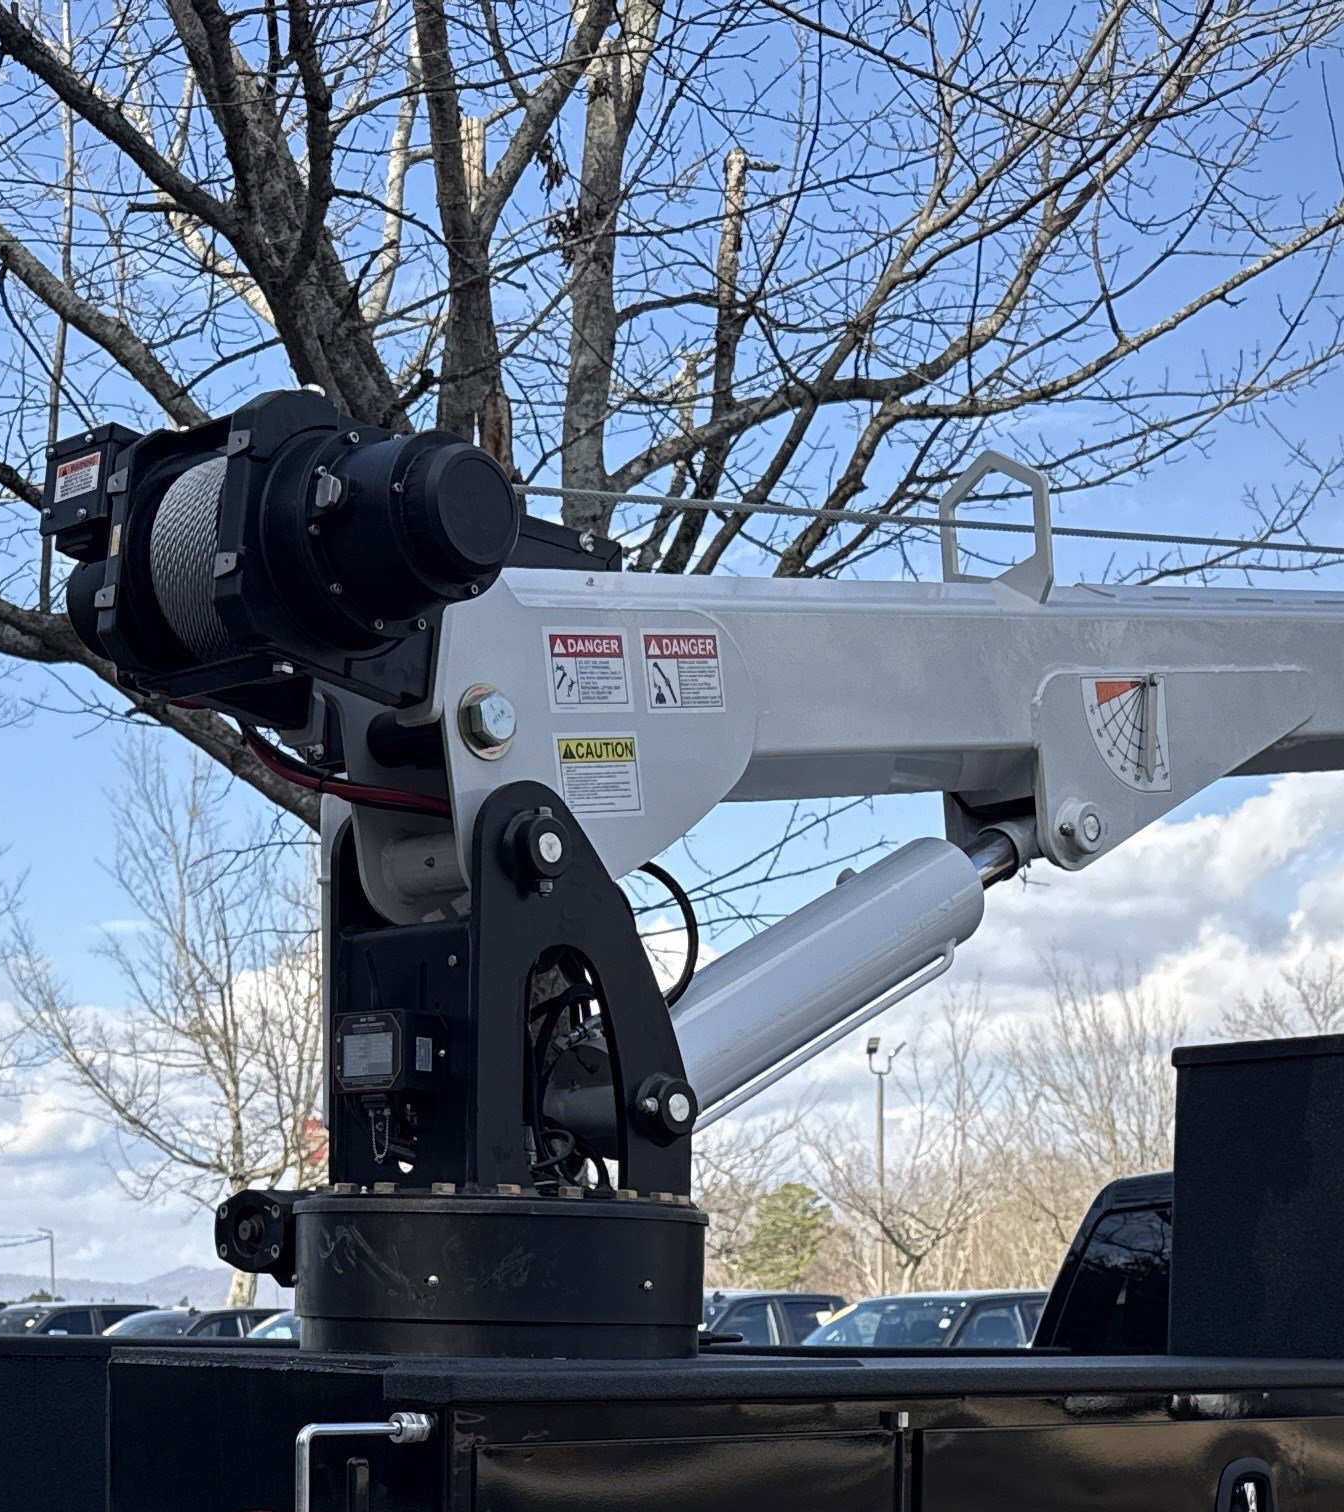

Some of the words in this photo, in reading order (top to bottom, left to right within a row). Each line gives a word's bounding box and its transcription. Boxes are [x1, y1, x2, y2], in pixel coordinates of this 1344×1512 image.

[567, 638, 620, 654] DANGER
[662, 637, 716, 655] DANGER
[575, 741, 634, 759] CAUTION
